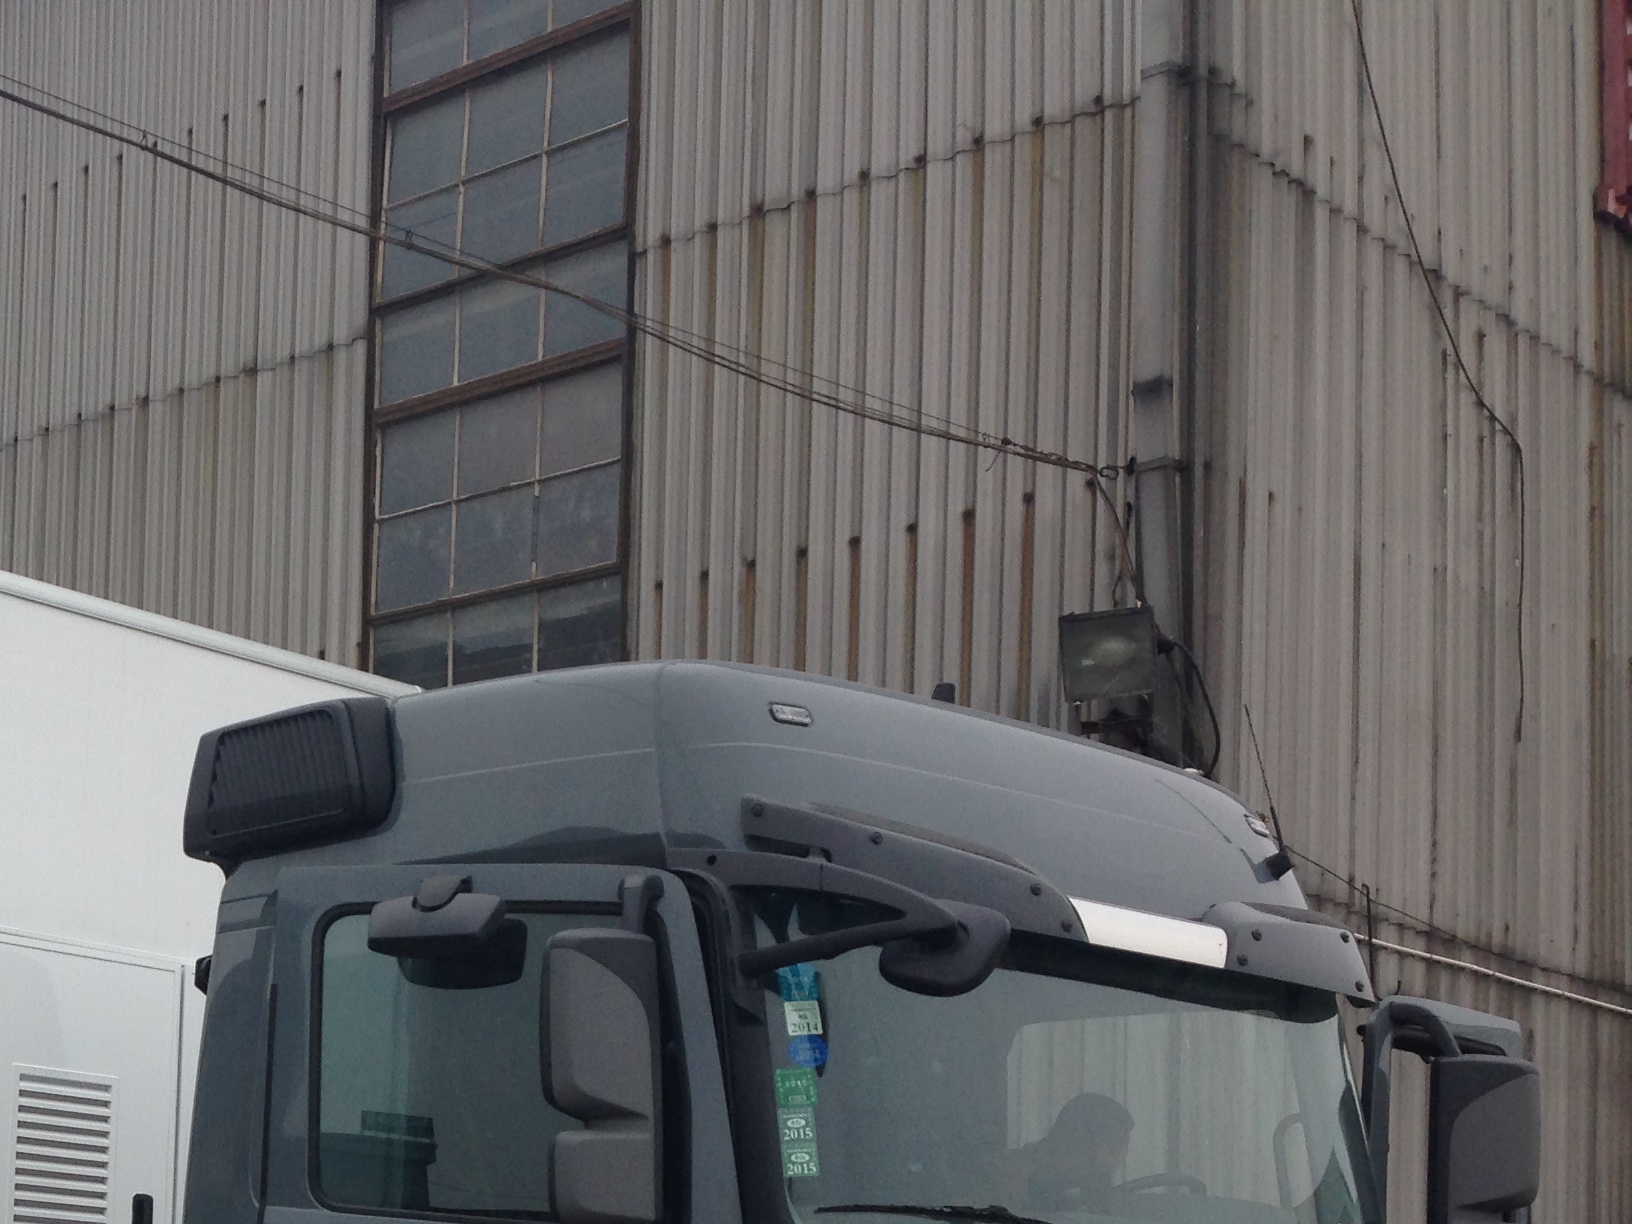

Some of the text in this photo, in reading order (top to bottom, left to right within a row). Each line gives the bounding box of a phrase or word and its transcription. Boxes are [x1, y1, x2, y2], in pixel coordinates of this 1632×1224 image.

[790, 1022, 819, 1034] 2014
[783, 1127, 813, 1141] 2015
[786, 1162, 817, 1175] 2015
